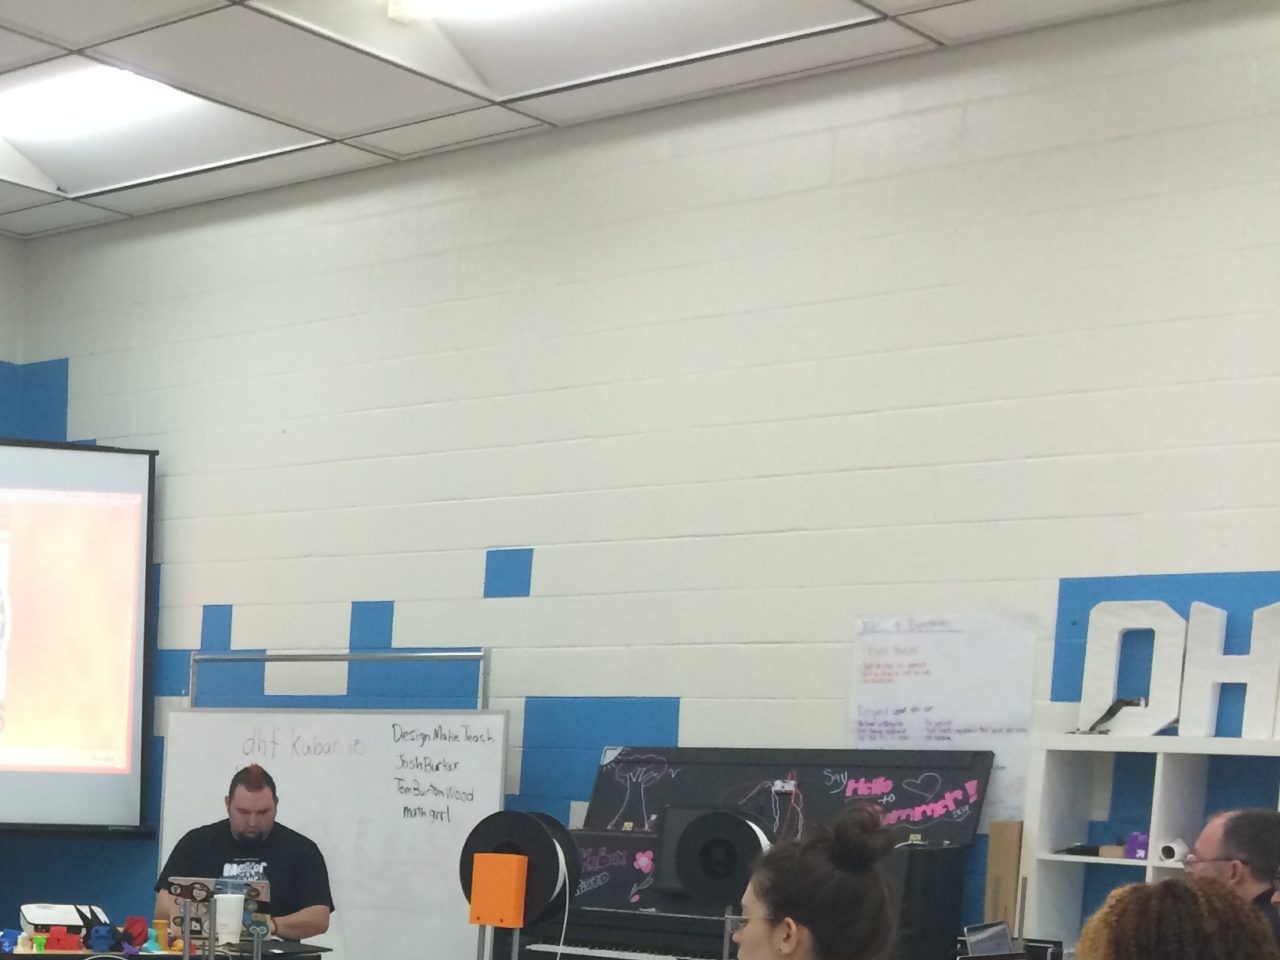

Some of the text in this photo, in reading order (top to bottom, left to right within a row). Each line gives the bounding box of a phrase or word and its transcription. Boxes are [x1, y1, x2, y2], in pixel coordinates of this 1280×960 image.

[1076, 599, 1280, 738] DH
[823, 768, 893, 797] Say Hello
